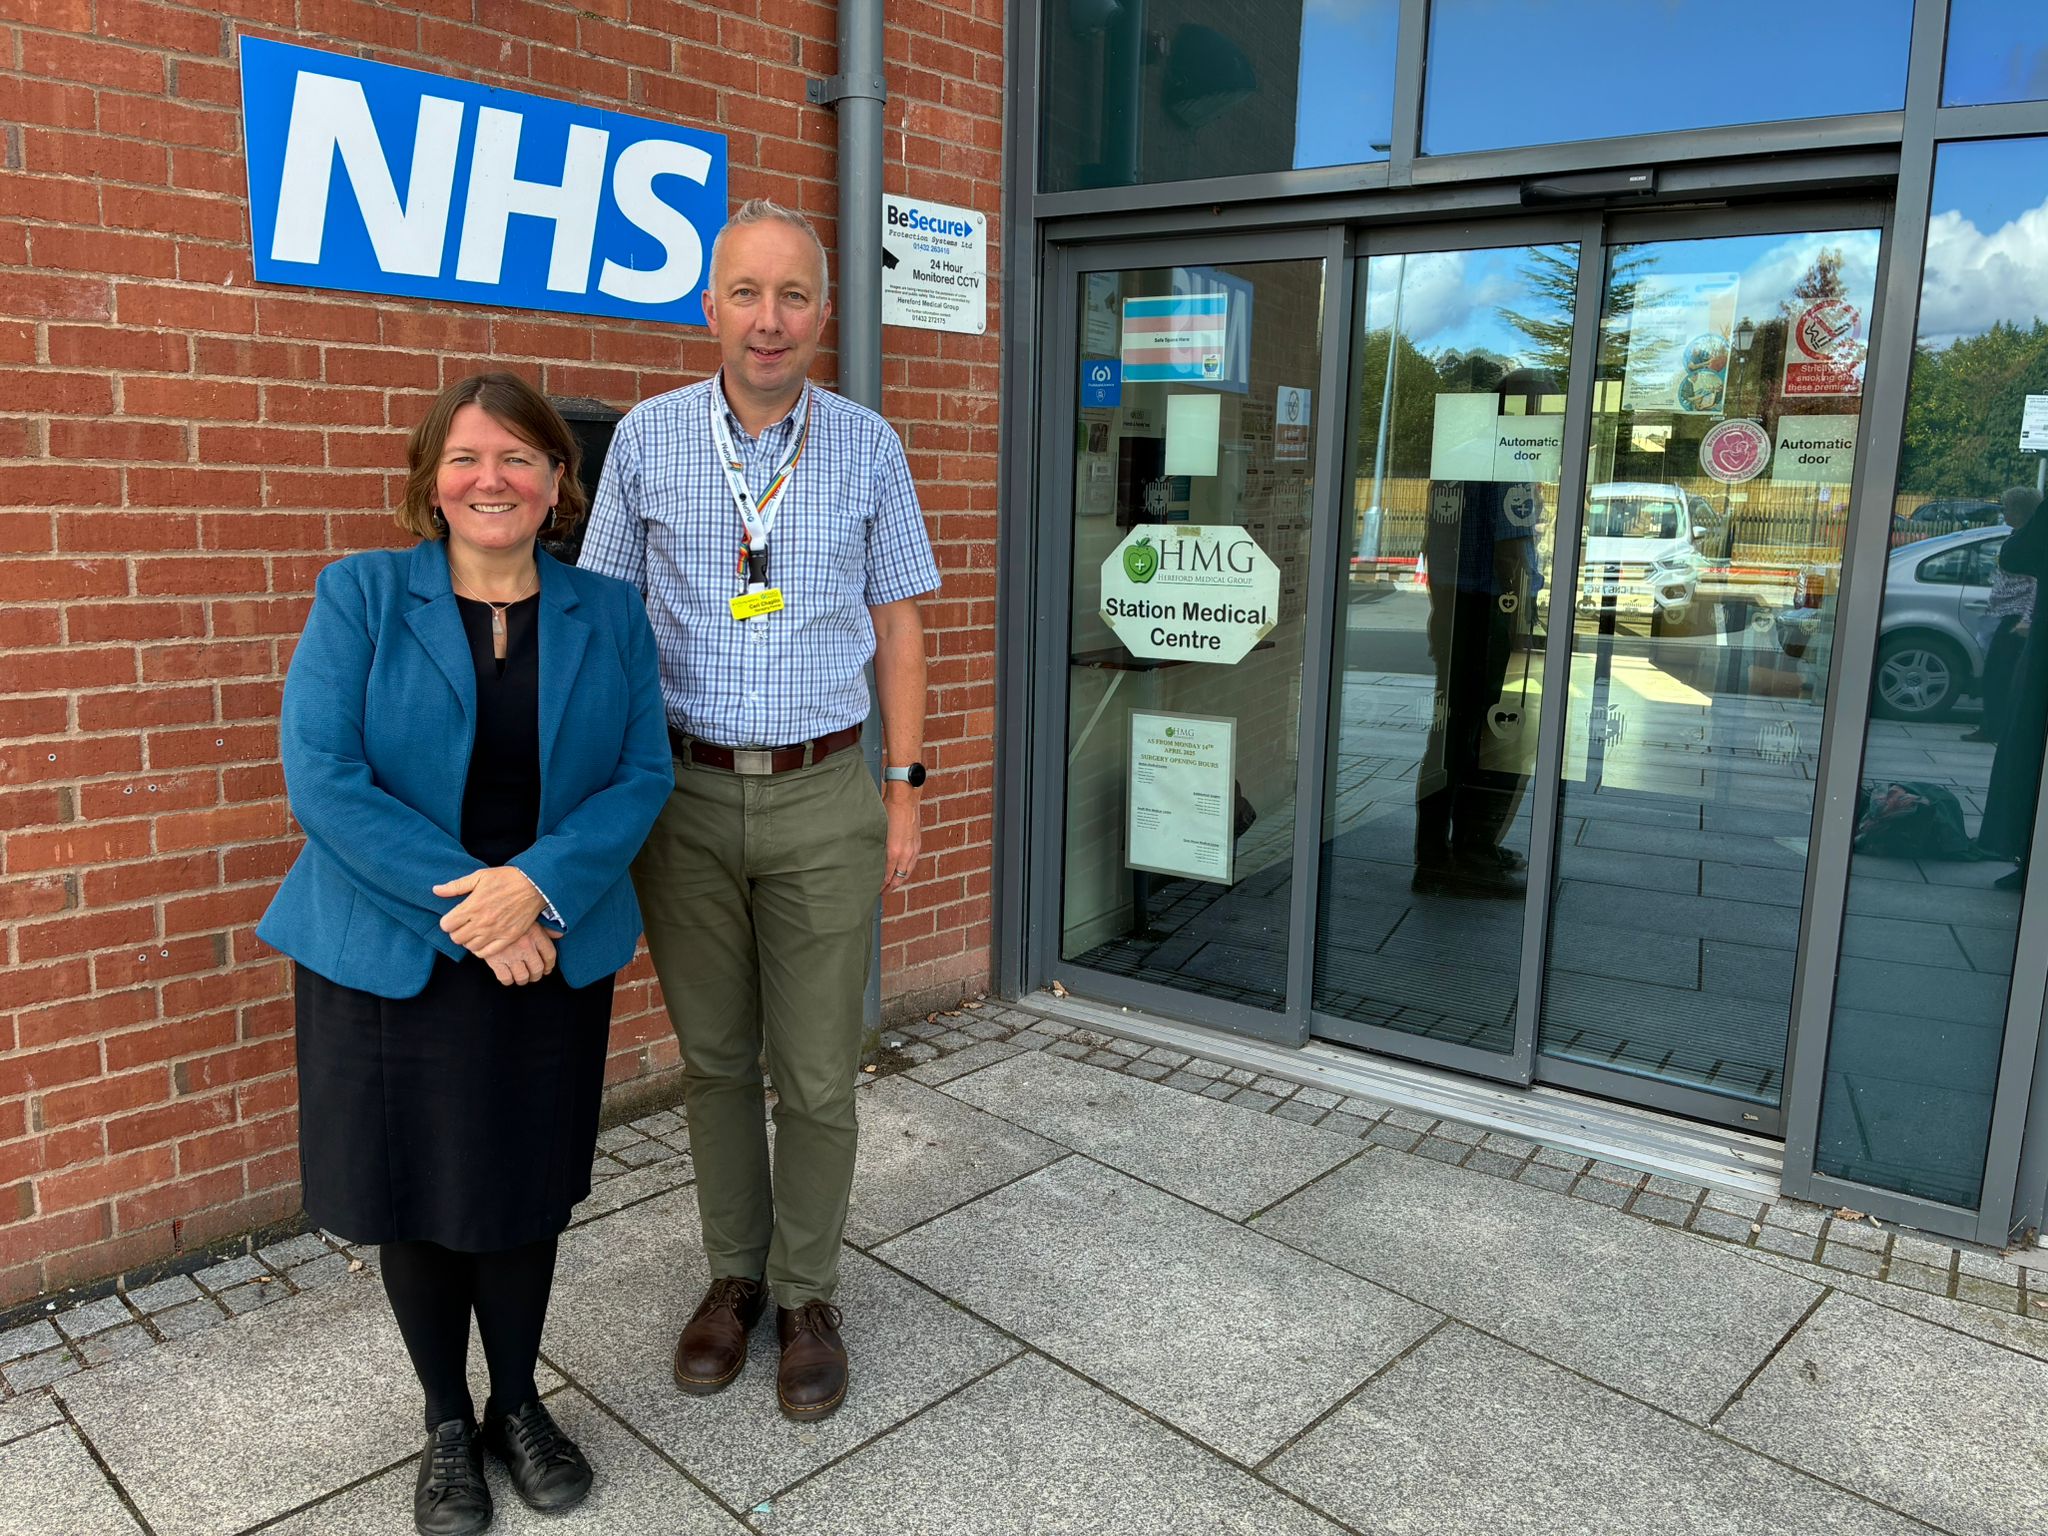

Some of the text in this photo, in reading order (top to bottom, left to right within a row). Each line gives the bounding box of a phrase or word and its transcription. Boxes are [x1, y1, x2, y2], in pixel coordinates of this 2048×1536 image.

[270, 70, 713, 305] NHS
[887, 204, 964, 238] BeSecure
[888, 229, 973, 249] Protection Systems Ltd
[930, 259, 964, 274] 24 Hour
[912, 269, 979, 289] Monitored CCTV
[897, 297, 921, 306] Hereford
[943, 302, 960, 311] Group
[1797, 374, 1836, 383] smoking
[1788, 383, 1813, 391] these
[1499, 437, 1559, 447] Automatic
[1780, 438, 1853, 450] Automatic
[1514, 450, 1542, 460] door
[1797, 453, 1832, 465] door
[1158, 539, 1256, 574] HMG
[1106, 597, 1267, 625] Station Medical
[1150, 627, 1221, 650] Centre
[1173, 727, 1195, 737] HMG
[1155, 739, 1174, 747] FROM
[1174, 741, 1202, 750] MONDAY
[1164, 747, 1182, 755] APRIL
[1140, 754, 1168, 763] SURGERY
[1169, 757, 1198, 766] OPENING
[1198, 760, 1219, 769] HOURS
